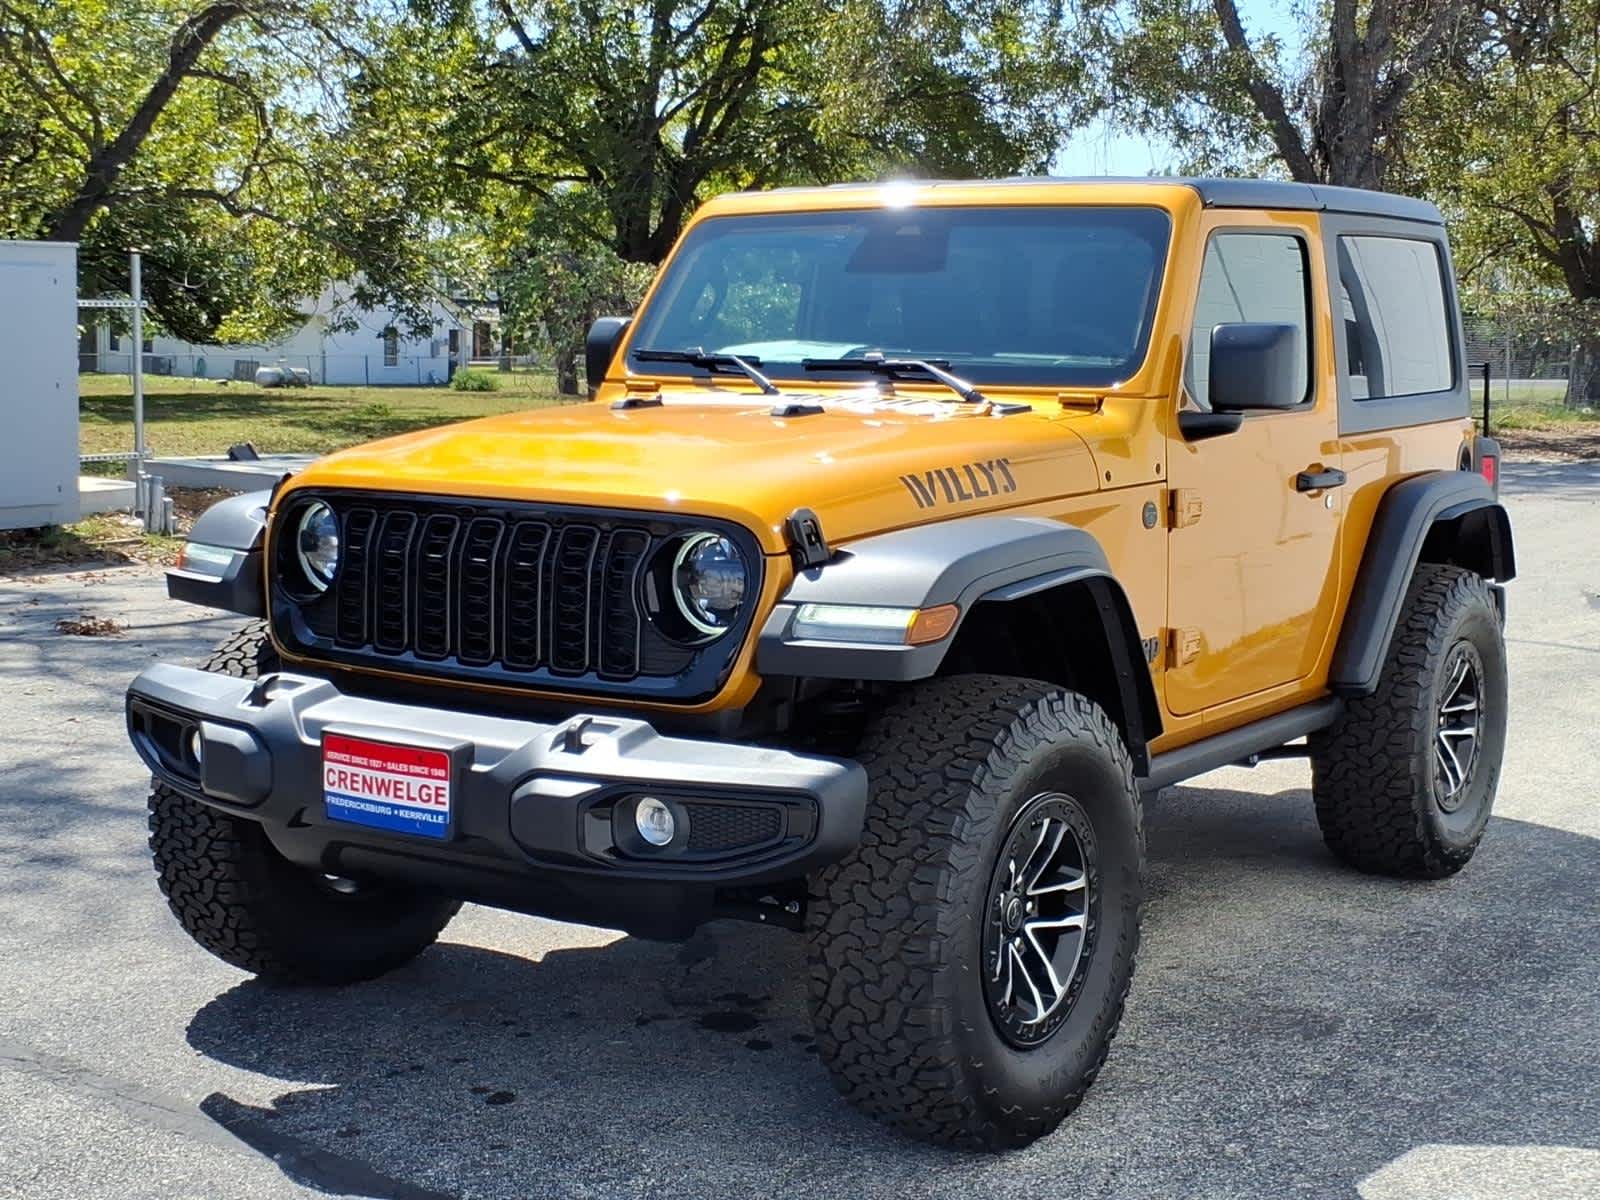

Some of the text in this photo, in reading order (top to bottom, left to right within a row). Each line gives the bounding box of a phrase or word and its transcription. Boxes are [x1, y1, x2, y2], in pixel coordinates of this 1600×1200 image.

[898, 458, 1017, 509] WILLYS
[387, 762, 408, 772] SALES
[326, 768, 447, 806] CRENWELGE
[327, 796, 445, 823] FREDERICKSBURG KERRVILLE
